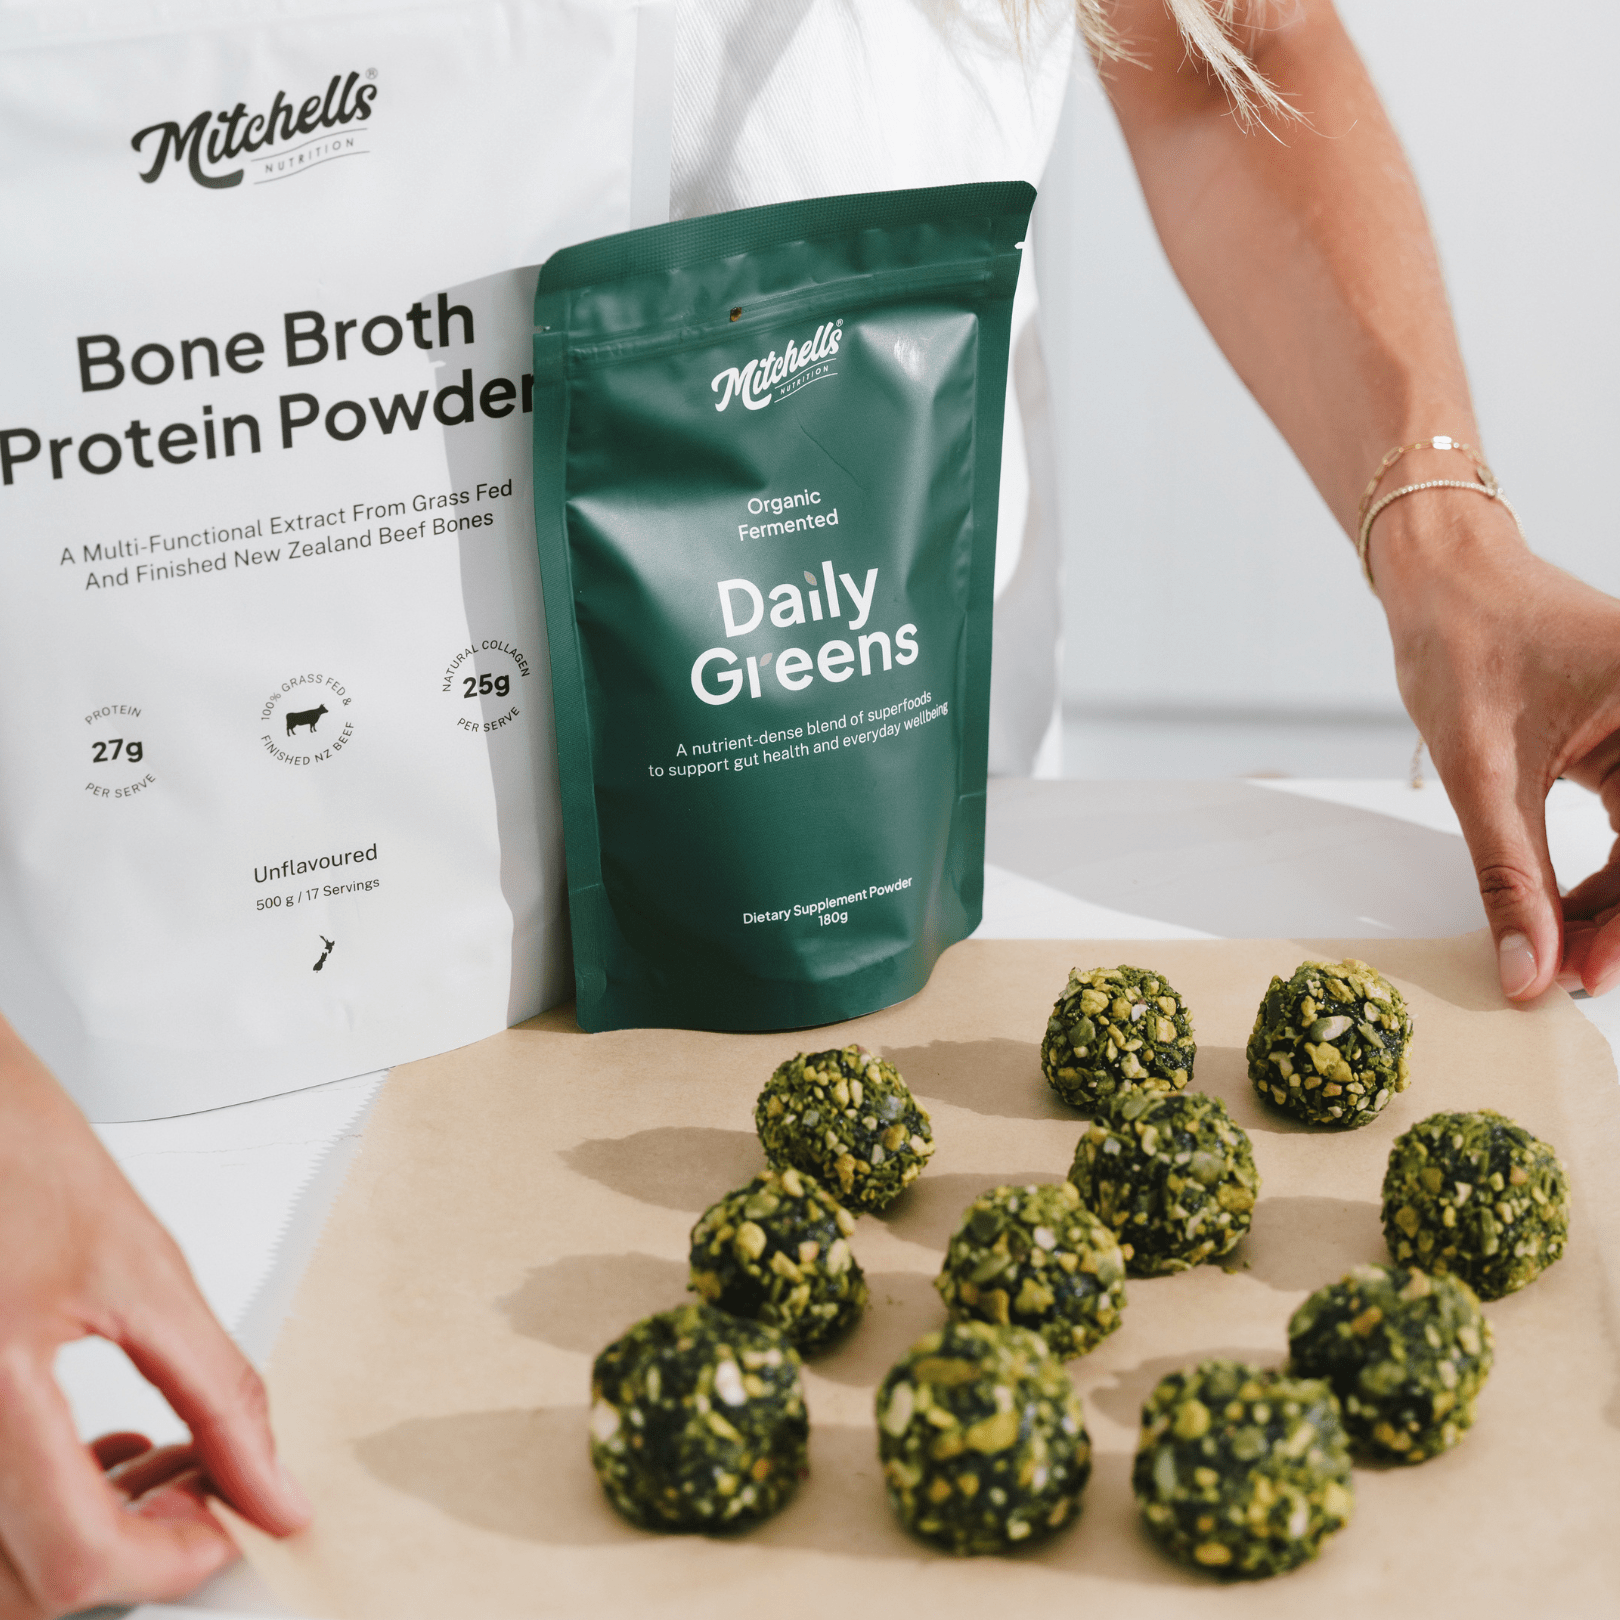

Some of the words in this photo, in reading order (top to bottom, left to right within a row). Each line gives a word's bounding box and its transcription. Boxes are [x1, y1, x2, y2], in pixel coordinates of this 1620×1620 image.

[131, 70, 377, 189] Mitchells
[265, 137, 355, 173] NUTRITION
[76, 330, 265, 393] Bone
[284, 293, 475, 367] Broth
[711, 322, 842, 412] Mitchells
[780, 365, 829, 394] NUTRITION
[0, 406, 261, 486] Protein
[60, 548, 75, 566] A
[83, 519, 262, 563] Multi-Functional
[270, 507, 346, 535] Extract
[353, 500, 406, 522] From
[412, 490, 470, 512] Grass
[476, 479, 512, 502] Fed
[738, 509, 839, 541] Fermented
[747, 489, 821, 517] Organic
[85, 568, 128, 591] And
[136, 553, 227, 582] Finished
[234, 544, 281, 568] New
[288, 530, 372, 560] Zealand
[378, 522, 426, 545] Beef
[432, 511, 494, 536] Bones
[717, 560, 878, 638] Daily
[443, 643, 479, 692] NATURAL
[482, 640, 530, 677] COLLAGEN
[463, 673, 510, 699] 25g
[691, 623, 919, 705] Greens
[85, 705, 141, 725] PROTEIN
[261, 691, 282, 721] 100%
[282, 674, 323, 693] GRASS
[326, 677, 347, 696] FED
[457, 717, 479, 732] PER
[483, 706, 520, 733] SERVE
[261, 734, 311, 765] FINISHED
[315, 750, 332, 763] NZ
[332, 721, 354, 752] BEEF
[649, 764, 664, 777] to
[669, 759, 729, 777] support
[734, 754, 759, 771] gut
[763, 743, 809, 764] health
[813, 737, 839, 754] and
[843, 723, 901, 747] everyday
[904, 702, 948, 730] wellbeing
[676, 744, 687, 757] A
[692, 726, 802, 755] nutrient-dense
[807, 716, 846, 736] blend
[850, 711, 864, 725] of
[867, 691, 932, 723] superfoods
[91, 739, 143, 763] 27g
[85, 782, 110, 798] PER
[115, 774, 156, 798] SERVE
[253, 843, 378, 883] Unflavoured
[256, 895, 282, 911] 500
[286, 895, 294, 907] g
[306, 888, 319, 901] 17
[323, 877, 380, 898] Servings
[743, 907, 791, 925] Dietary
[794, 890, 867, 916] Supplement
[869, 877, 912, 898] Powder
[818, 911, 848, 927] 180g
